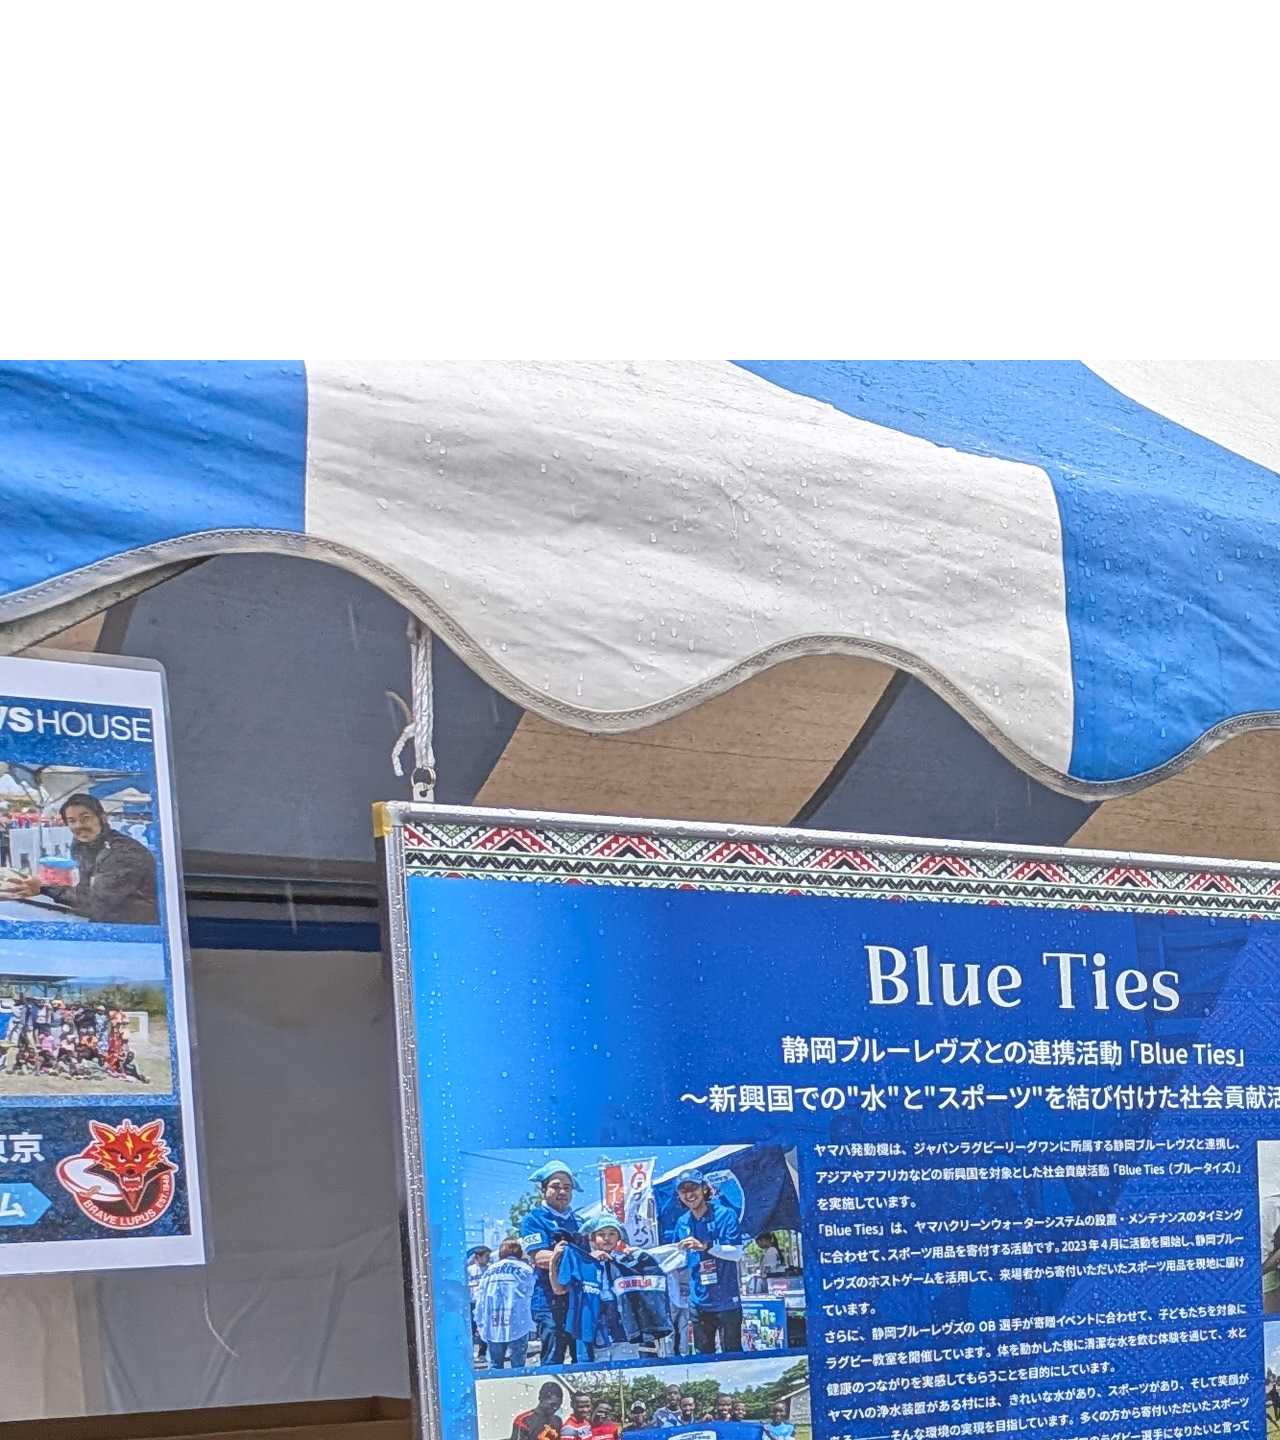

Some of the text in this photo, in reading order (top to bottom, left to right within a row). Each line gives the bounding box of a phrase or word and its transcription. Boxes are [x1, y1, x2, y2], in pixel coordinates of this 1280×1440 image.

[864, 944, 1181, 1012] Blue Ties
[83, 1200, 117, 1225] BRAVE
[119, 1208, 157, 1226] LUPUS
[817, 1195, 917, 1211] を実施しています。
[822, 1302, 876, 1316] ています。
